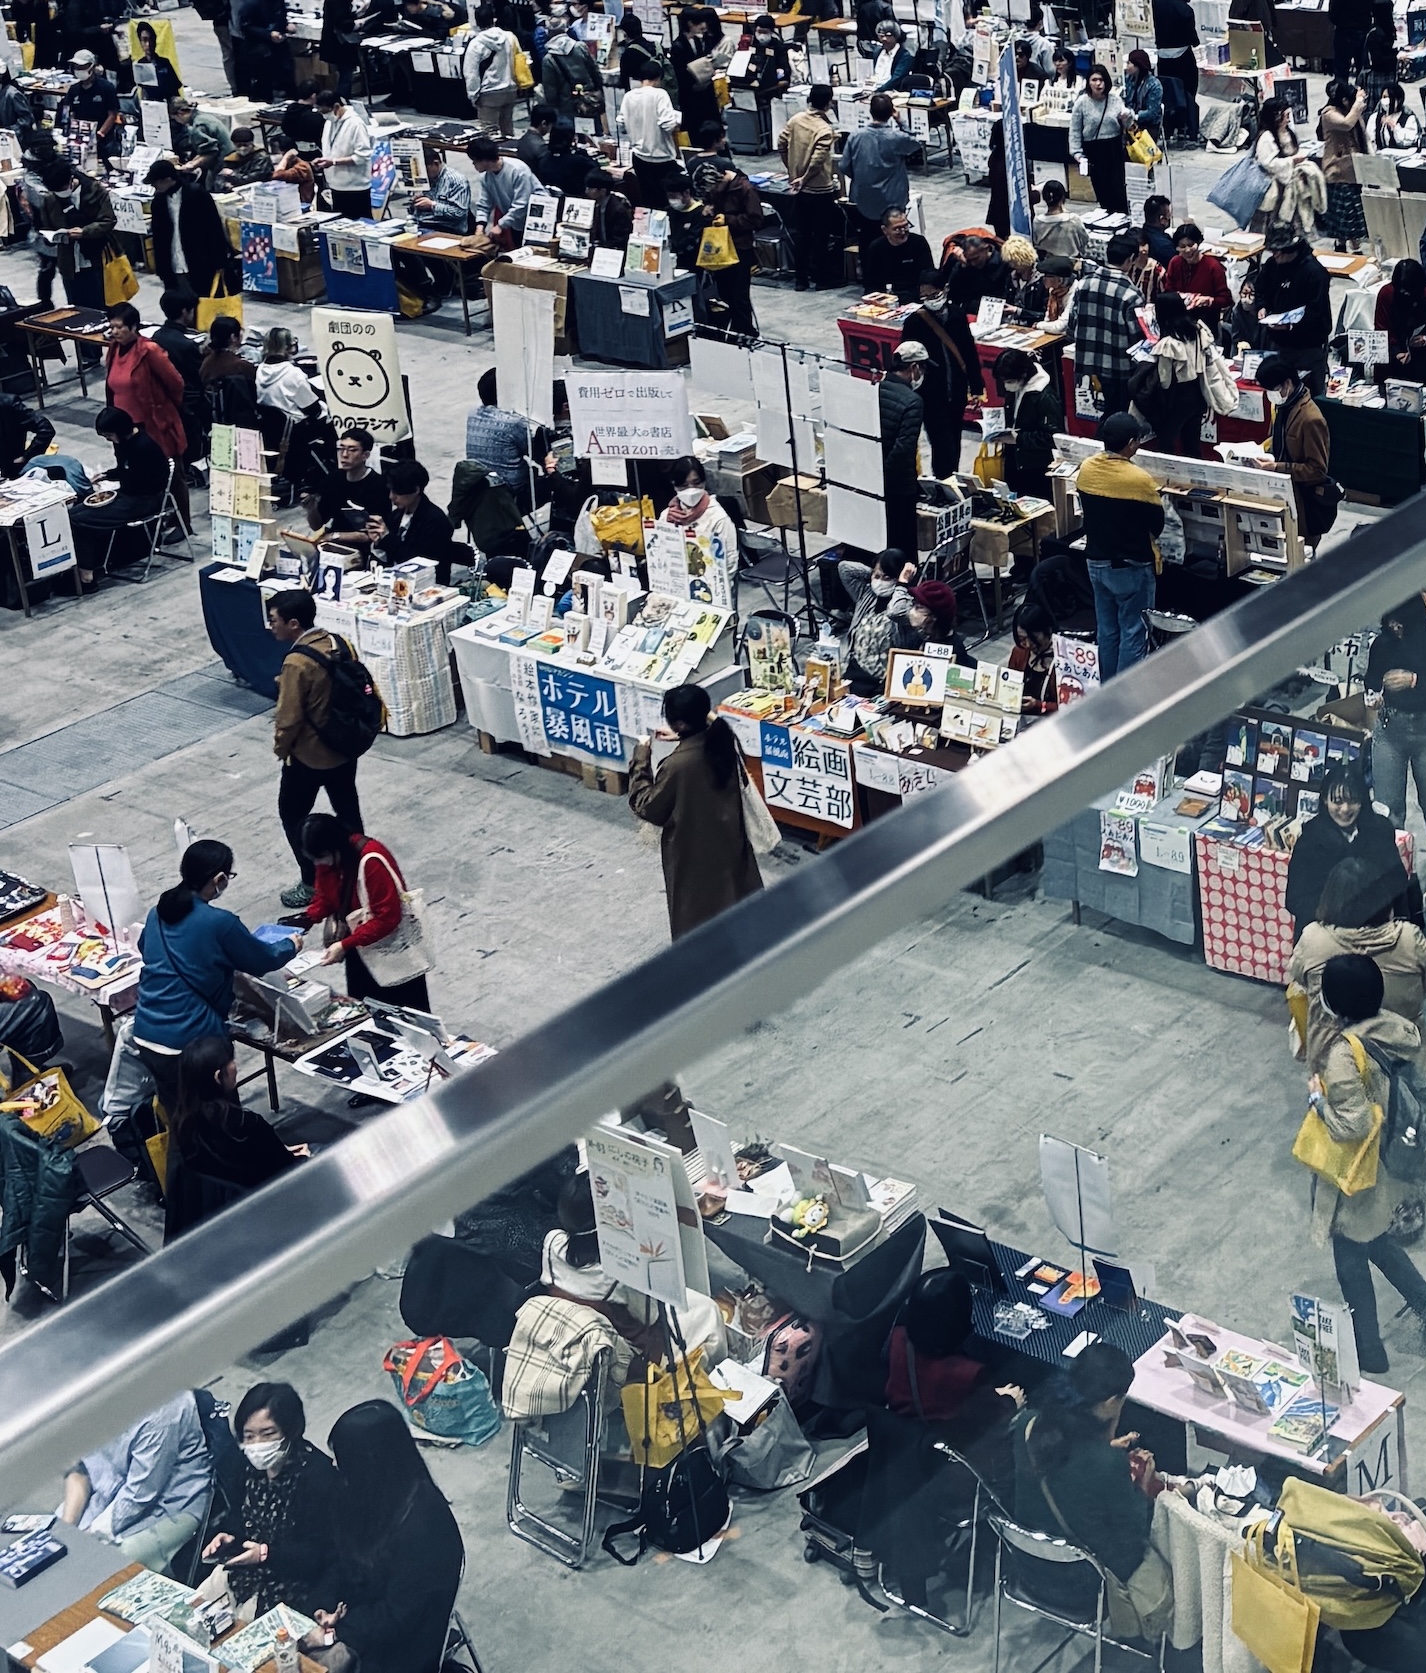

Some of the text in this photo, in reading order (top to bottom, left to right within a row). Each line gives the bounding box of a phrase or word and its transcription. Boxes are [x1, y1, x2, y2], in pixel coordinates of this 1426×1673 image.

[328, 320, 376, 335] 劇団のの
[577, 385, 674, 400] 費用ゼロで出版して
[332, 414, 398, 432] ののラジオ
[594, 425, 673, 438] 世界最大の書店
[36, 518, 61, 548] L
[926, 646, 950, 657] L-88
[541, 674, 617, 718] ホテル
[545, 706, 622, 756] 暴風雨
[792, 736, 849, 781] 絵画
[765, 770, 851, 821] 文芸部
[1354, 1431, 1394, 1499] M
